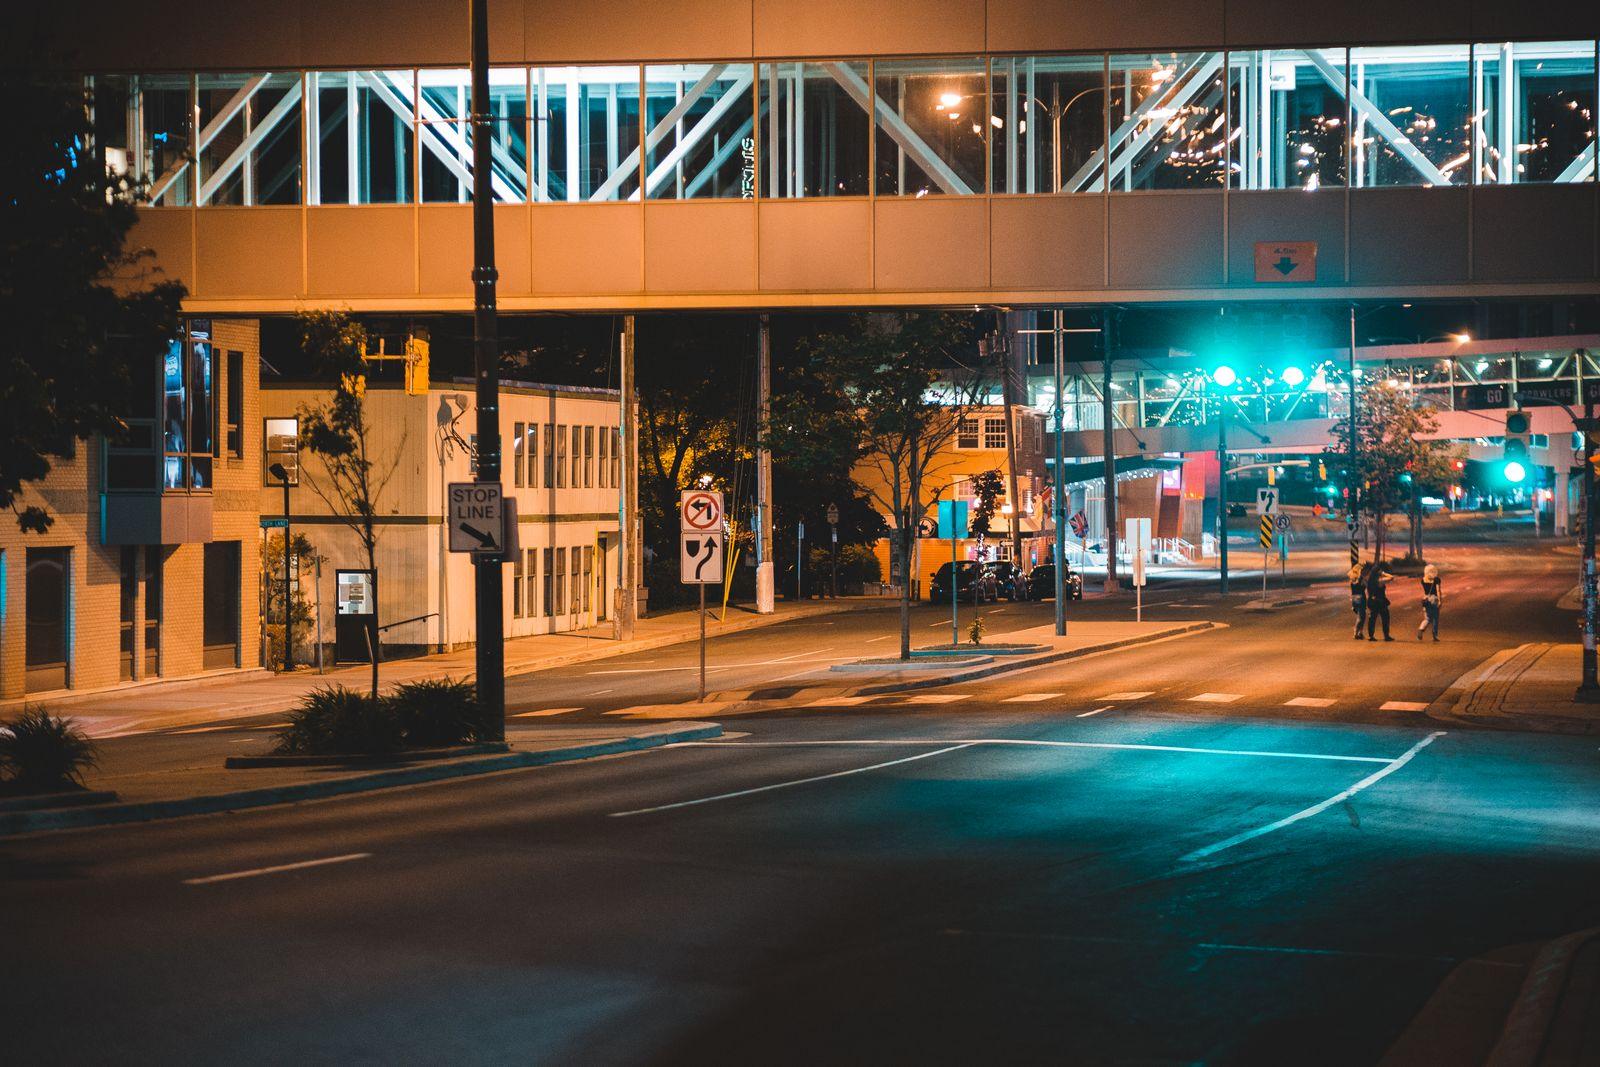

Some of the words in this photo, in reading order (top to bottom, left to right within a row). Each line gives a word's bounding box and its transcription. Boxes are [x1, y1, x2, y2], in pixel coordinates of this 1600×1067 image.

[1487, 390, 1502, 403] GO
[453, 488, 498, 503] STOP
[457, 505, 494, 519] LINE
